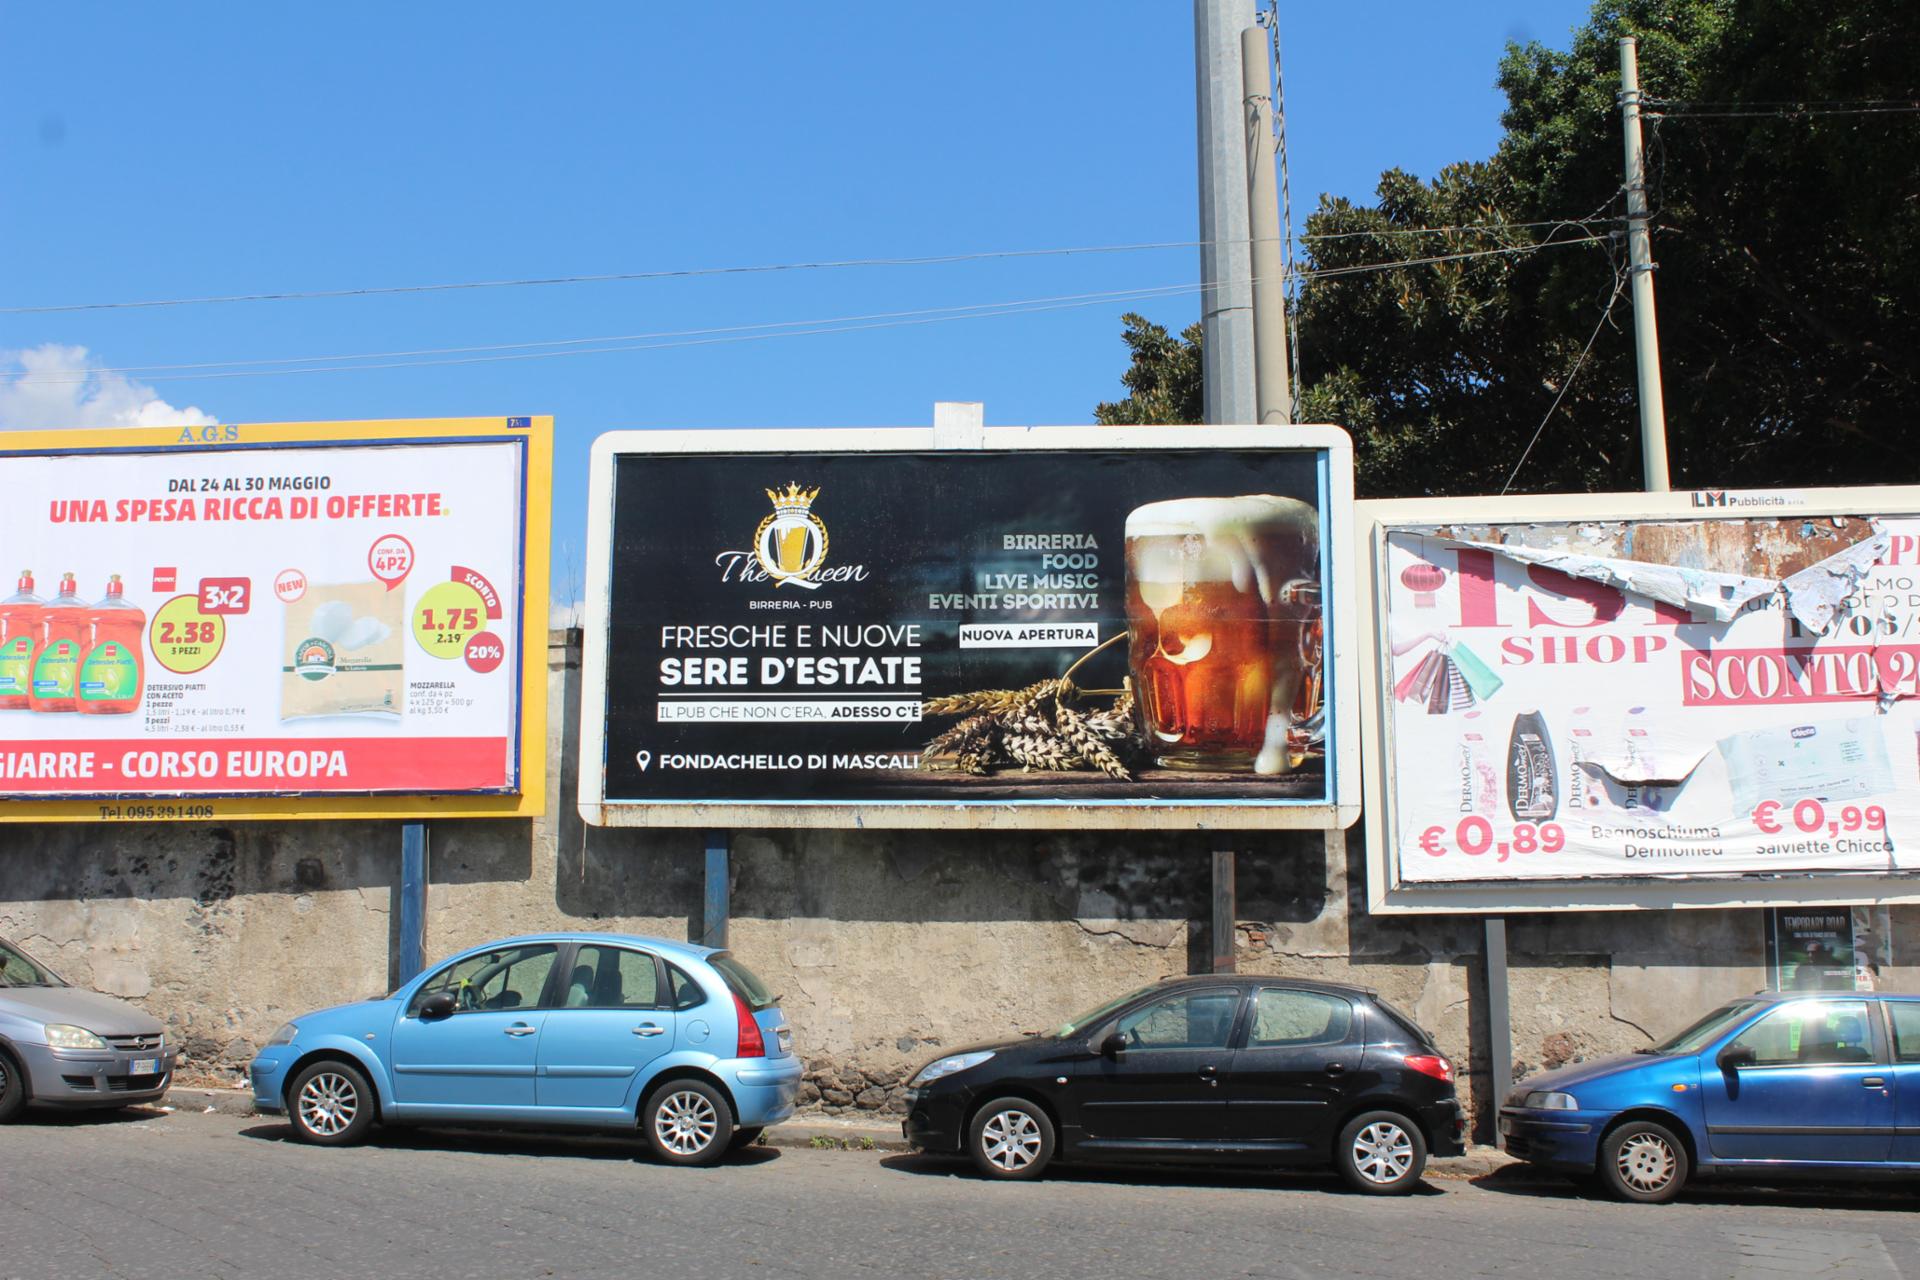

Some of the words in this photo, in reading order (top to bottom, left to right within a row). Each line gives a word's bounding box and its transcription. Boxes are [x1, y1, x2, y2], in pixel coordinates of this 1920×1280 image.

[178, 425, 239, 443] A.G.S
[168, 479, 196, 492] DAL
[200, 478, 219, 492] 24
[223, 478, 241, 491] AL
[245, 477, 264, 491] 30
[268, 476, 331, 491] MAGGIO
[49, 500, 108, 523] UNA
[115, 499, 196, 522] SPESA
[203, 497, 284, 521] RICCA
[290, 496, 318, 519] DI
[1729, 496, 1785, 507] Pubblicità
[1003, 534, 1098, 550] BIRRERIA
[715, 551, 768, 583] The
[1042, 554, 1098, 570] FOOD
[277, 579, 303, 593] NEW
[985, 574, 1028, 590] LIVE
[1033, 573, 1099, 590] MUSIC
[204, 585, 245, 609] 3x2
[464, 573, 497, 608] SCONTO
[749, 601, 800, 610] BIRRERIA
[809, 601, 833, 610] PUB
[929, 594, 998, 610] EVENTI
[1003, 593, 1099, 610] SPORTIVI
[422, 608, 478, 630] 1.75
[160, 622, 216, 644] 2.38
[437, 634, 461, 643] 2.19
[661, 625, 786, 648] FRESCHE
[797, 625, 812, 648] E
[821, 624, 921, 648] NUOVE
[962, 630, 1013, 641] NUOVA
[1018, 629, 1095, 641] APERTURA
[179, 647, 201, 655] PEZZI
[469, 646, 500, 659] 20%
[1501, 634, 1667, 665] SHOP
[659, 657, 749, 685] SERE
[761, 656, 922, 685] D'ESTATE
[1690, 651, 1878, 700] SCONTO
[660, 706, 672, 718] IL
[677, 706, 705, 718] PUB
[709, 706, 739, 718] CHE
[744, 706, 776, 718] NON
[831, 706, 892, 718] ADESSO
[121, 751, 219, 778] CORSO
[226, 750, 348, 777] EUROPA
[659, 754, 803, 769] FONDACHELLO
[807, 754, 827, 769] DI
[832, 754, 919, 769] MASCALI
[1752, 800, 1783, 834] €
[1793, 799, 1885, 838] 0,99
[1418, 826, 1447, 857] €
[1456, 815, 1565, 862] 0,89
